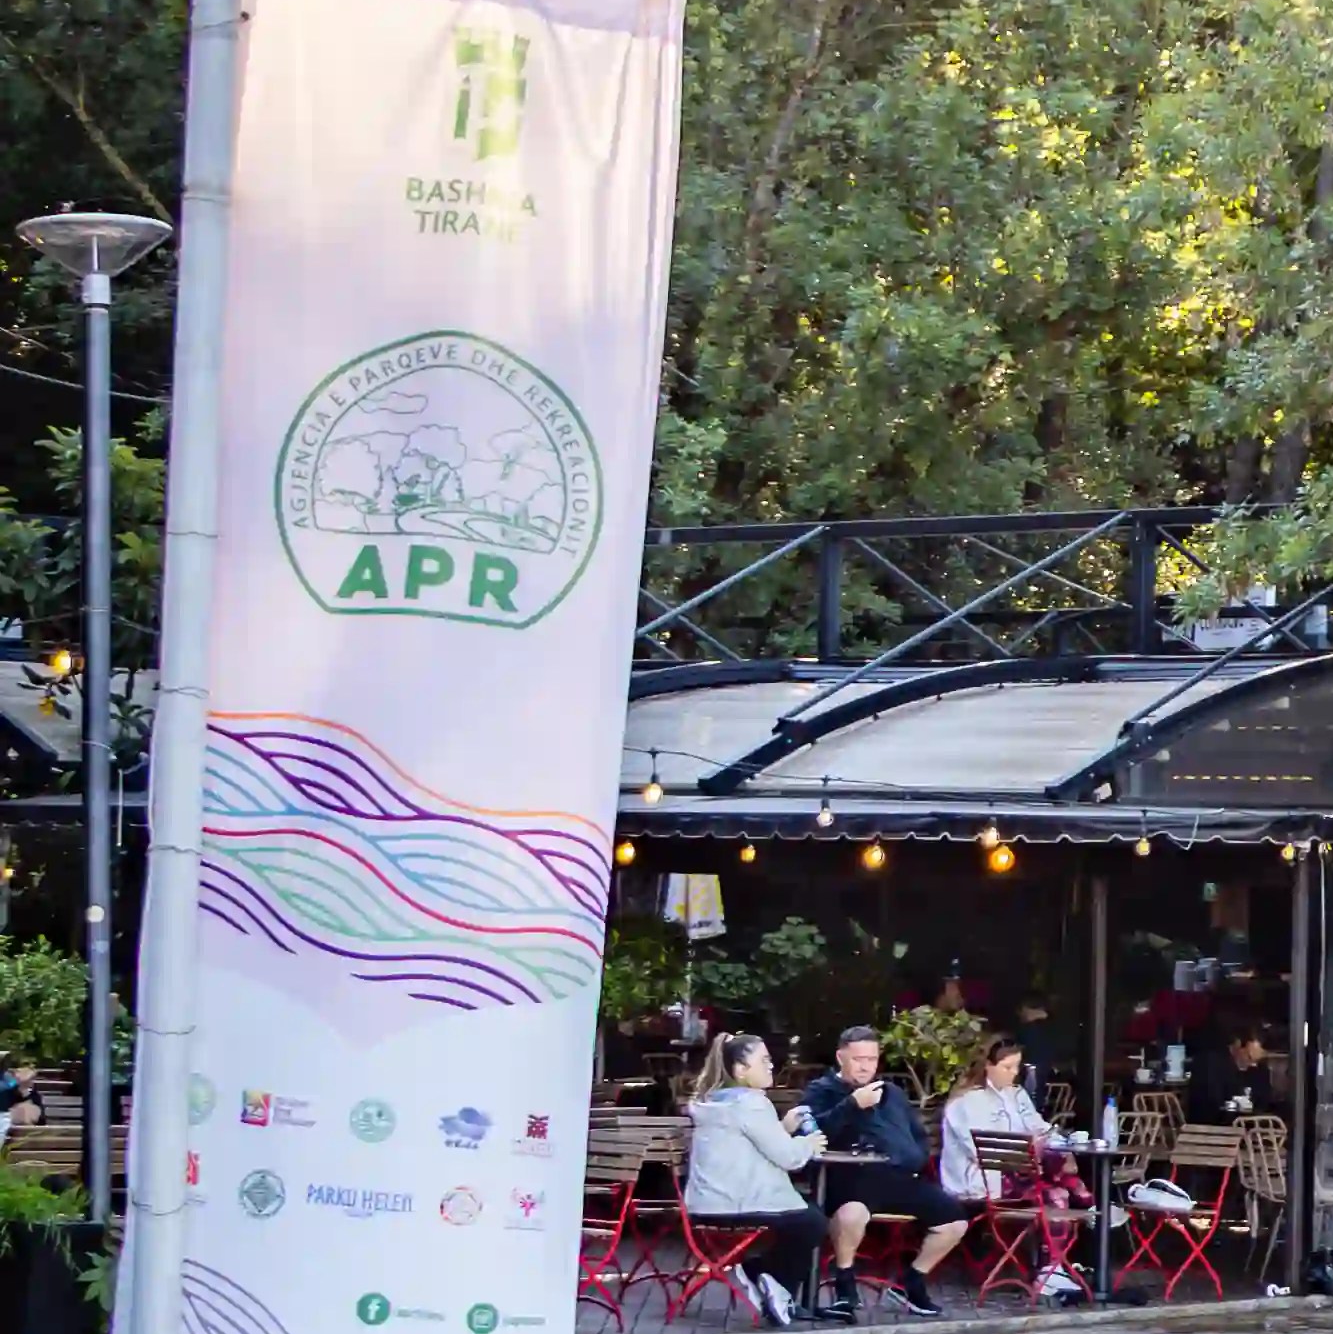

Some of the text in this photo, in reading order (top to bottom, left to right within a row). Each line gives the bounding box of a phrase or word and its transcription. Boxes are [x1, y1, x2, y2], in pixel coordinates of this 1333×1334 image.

[405, 176, 538, 217] BASHA
[413, 209, 515, 242] TIRA
[289, 343, 590, 560] AGJENCIA E PARQEVE DHE REKREACIONIT
[335, 543, 519, 613] APR
[305, 1182, 357, 1208] PARKU
